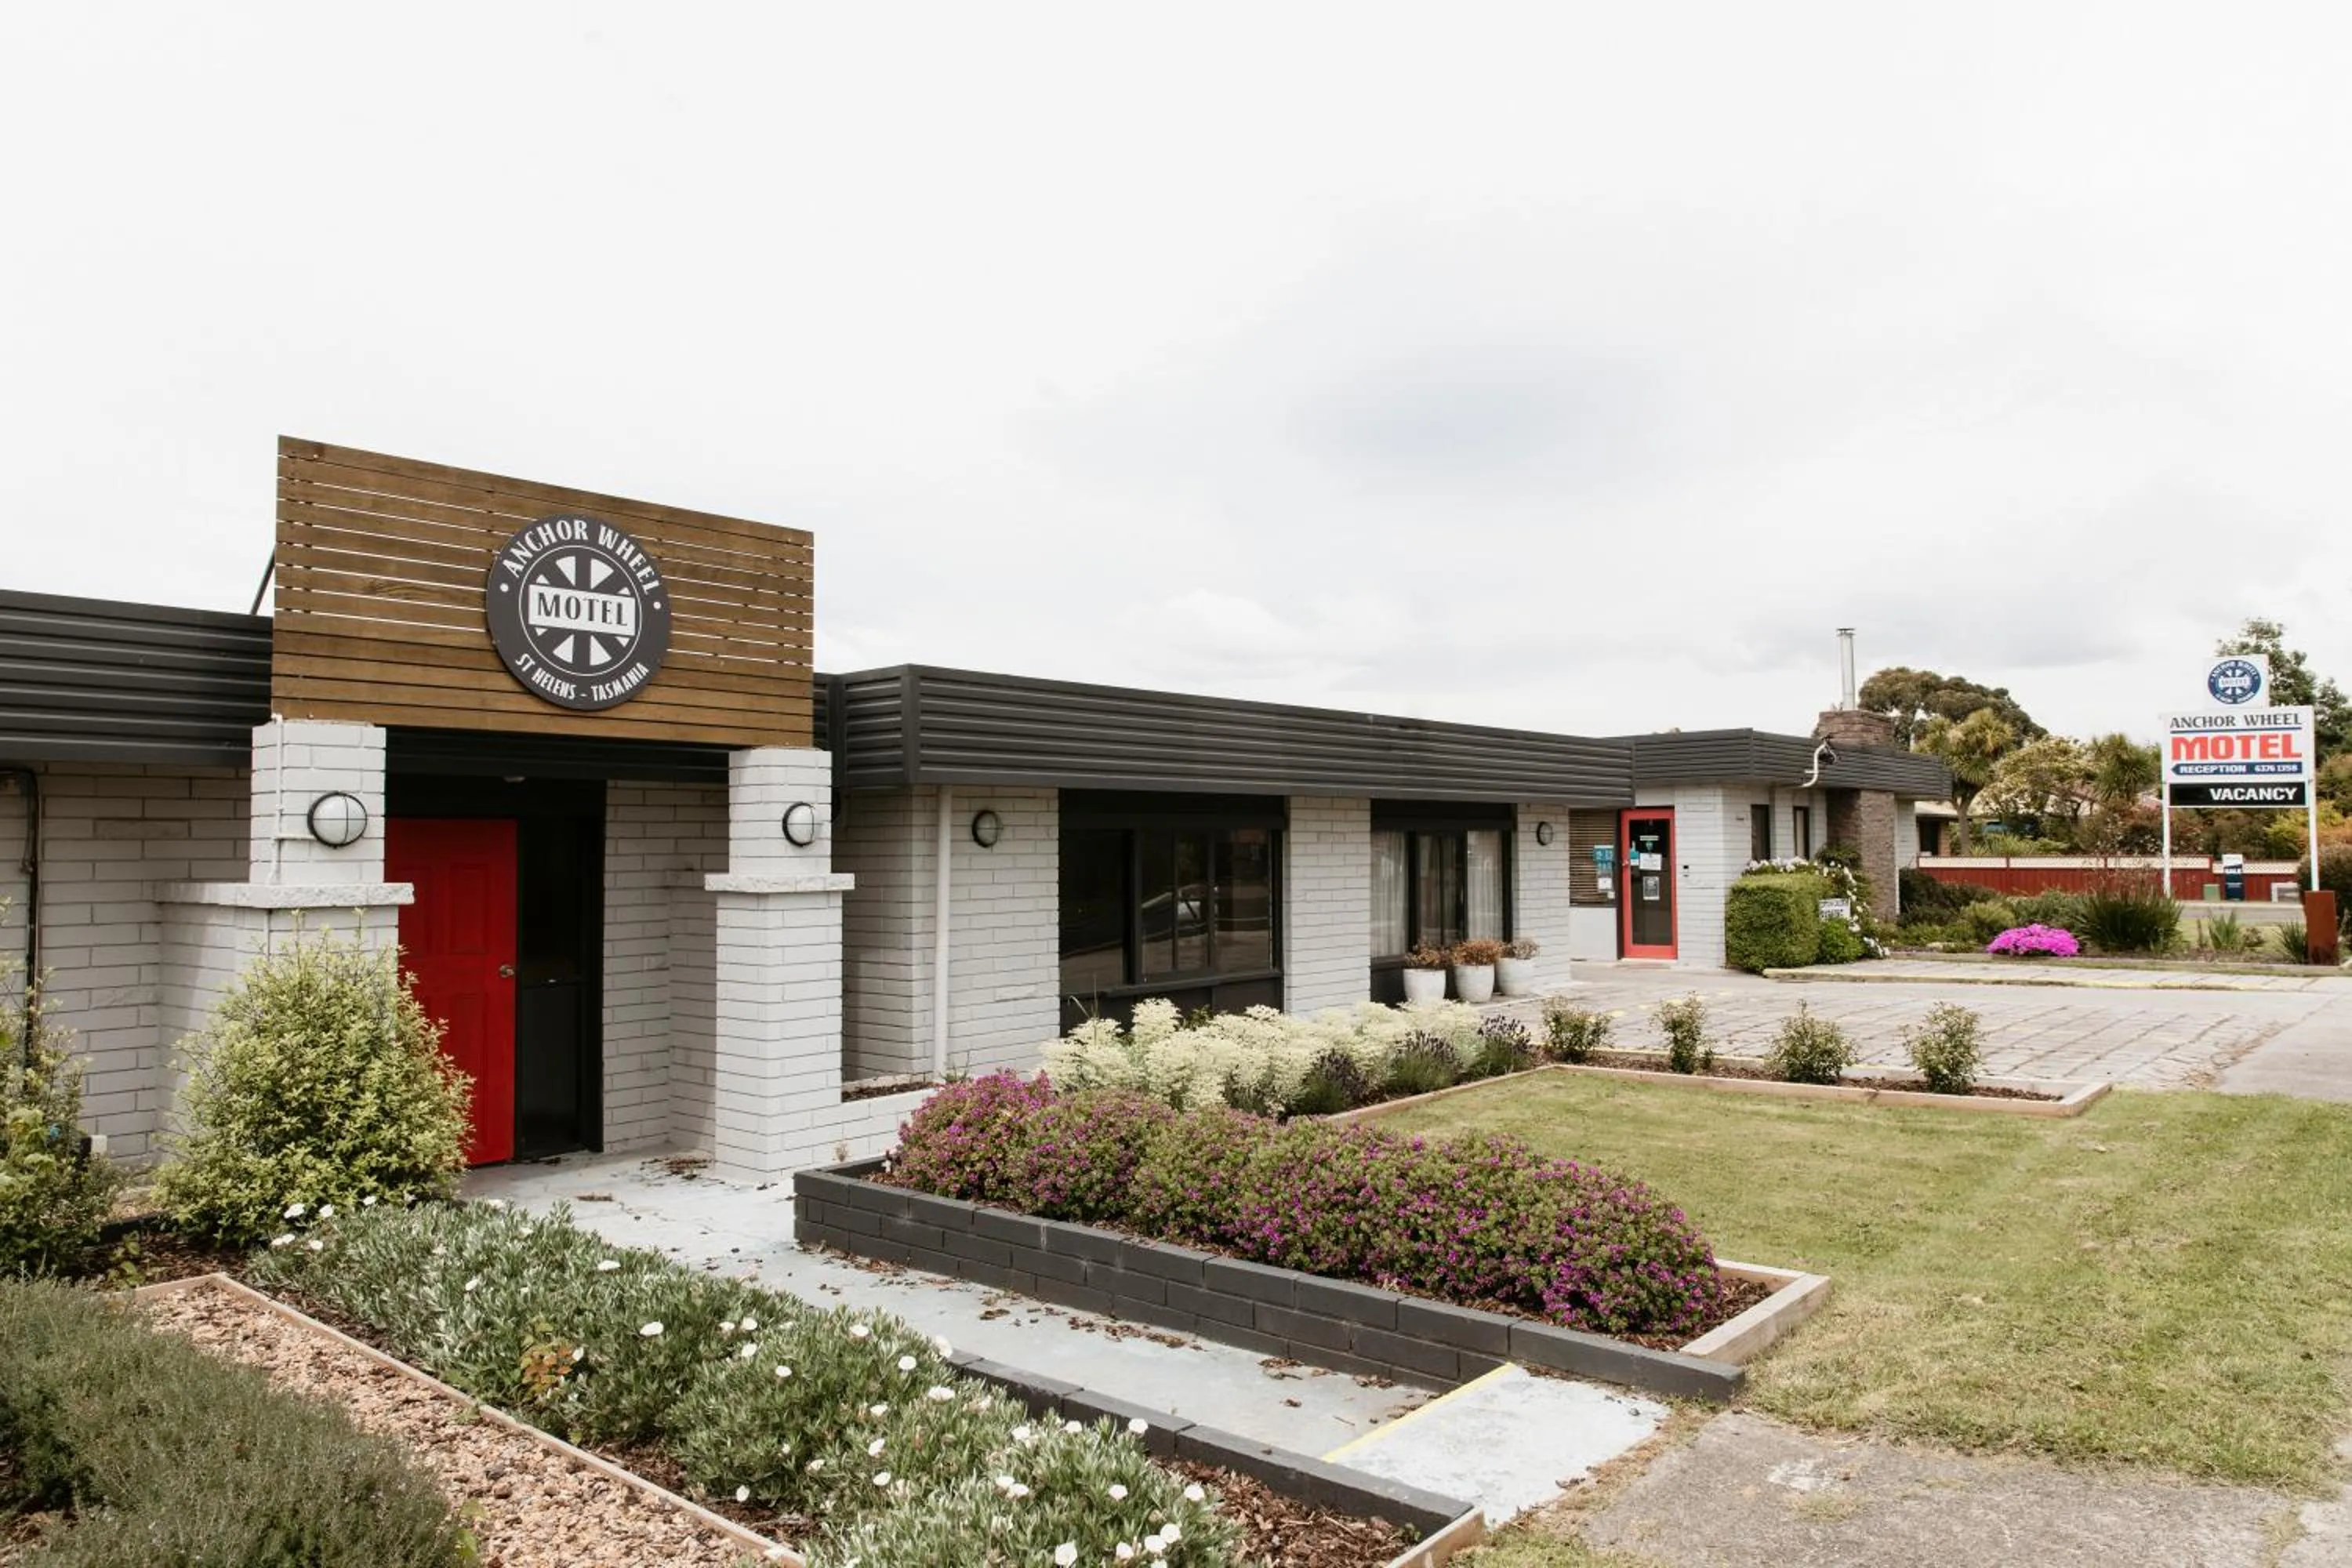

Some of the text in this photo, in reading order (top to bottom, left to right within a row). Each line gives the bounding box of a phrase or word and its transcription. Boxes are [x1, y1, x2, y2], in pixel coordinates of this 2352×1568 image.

[503, 520, 660, 595] ANCHOR WHEEL
[537, 592, 628, 626] MOTEL
[515, 653, 535, 670] ST
[532, 668, 577, 700] HELENS
[590, 662, 650, 702] TASMANIA
[2170, 713, 2302, 728] ANCHOR WHEEL
[2171, 733, 2303, 761] MOTEL
[2179, 764, 2247, 774] RECEPTION
[2209, 787, 2298, 800] VACANCY
